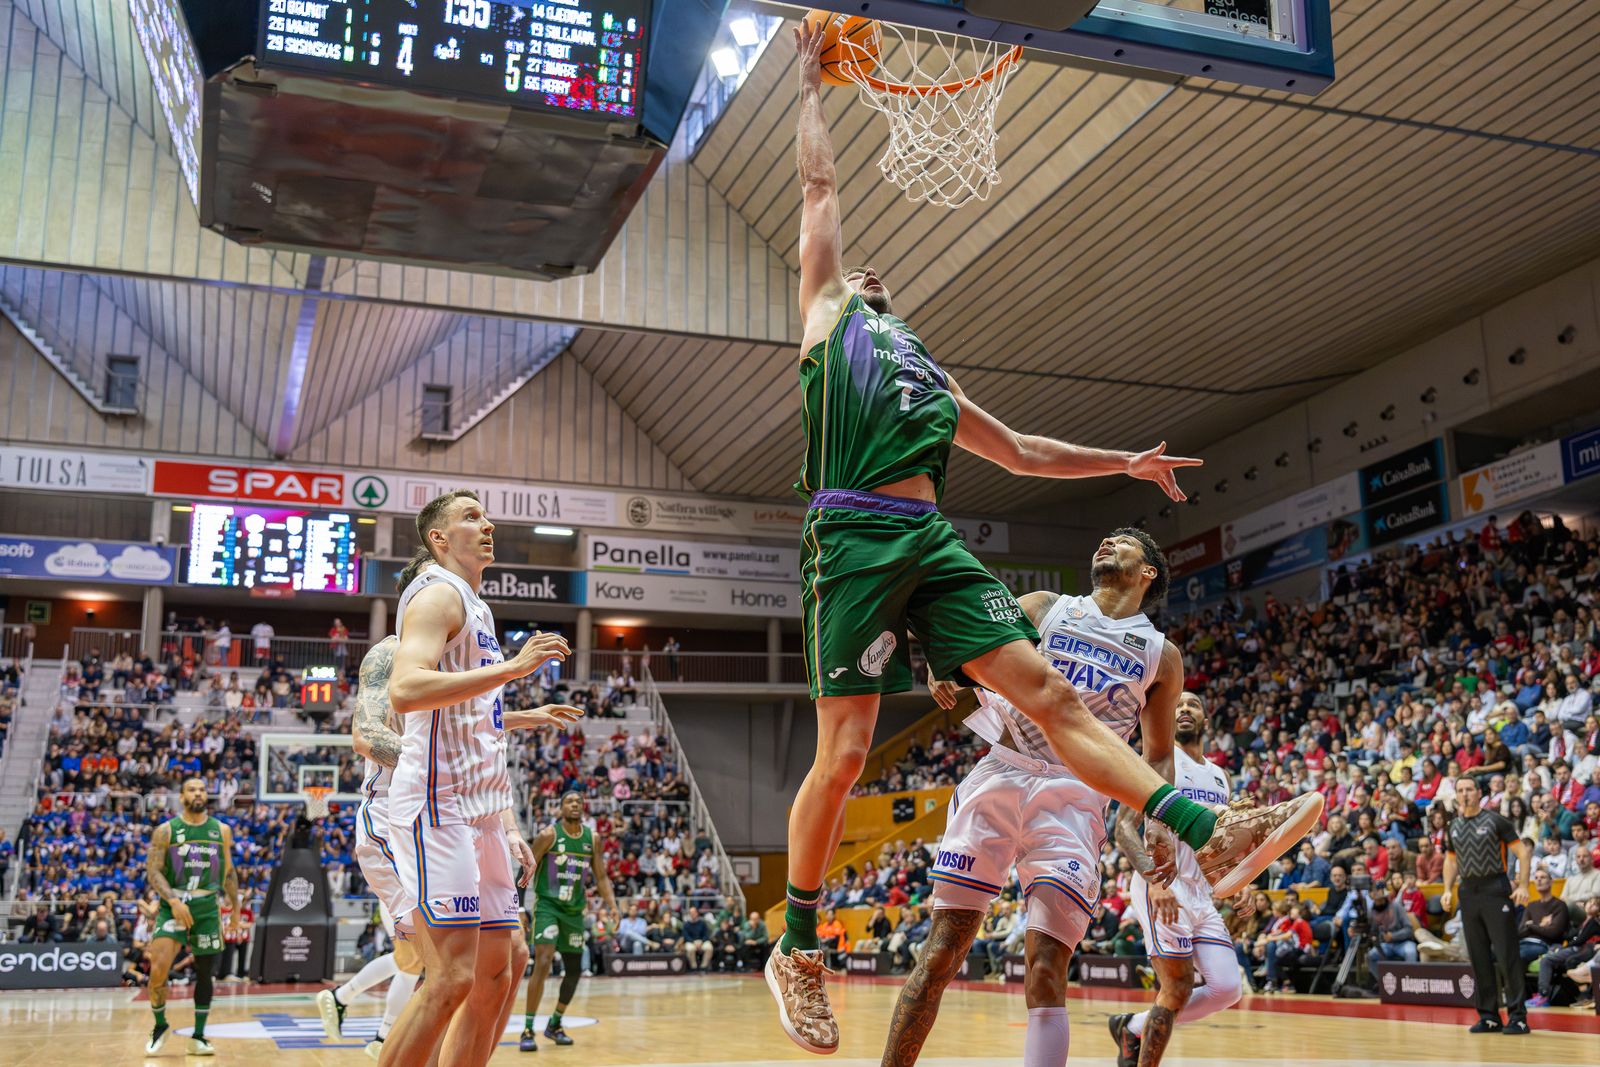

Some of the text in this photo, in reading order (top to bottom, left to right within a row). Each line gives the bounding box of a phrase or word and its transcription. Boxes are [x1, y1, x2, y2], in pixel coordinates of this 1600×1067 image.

[532, 3, 545, 18] 14
[267, 33, 284, 51] 29
[529, 40, 542, 54] 21
[396, 36, 413, 76] 4
[526, 57, 541, 72] 27
[505, 53, 521, 93] 5
[895, 380, 913, 410] 7
[16, 455, 87, 487] TULSÀ
[1382, 456, 1432, 487] CaixaBank
[208, 468, 342, 501] SPAR
[501, 490, 561, 519] TULSÀ
[1386, 500, 1437, 529] CaixaBank
[593, 541, 691, 567] Panella
[479, 572, 559, 600] xaBank
[595, 581, 645, 601] Kave
[980, 588, 1004, 600] sabor
[731, 589, 787, 609] Home
[987, 606, 1024, 624] laga
[1049, 632, 1146, 686] GIRONA
[307, 682, 332, 703] 11
[1181, 788, 1229, 805] GIRON
[190, 845, 218, 857] Unicaja
[936, 849, 977, 873] YOSOY
[452, 896, 480, 913] YOSO
[1176, 936, 1192, 949] YOS
[0, 947, 117, 972] endesa
